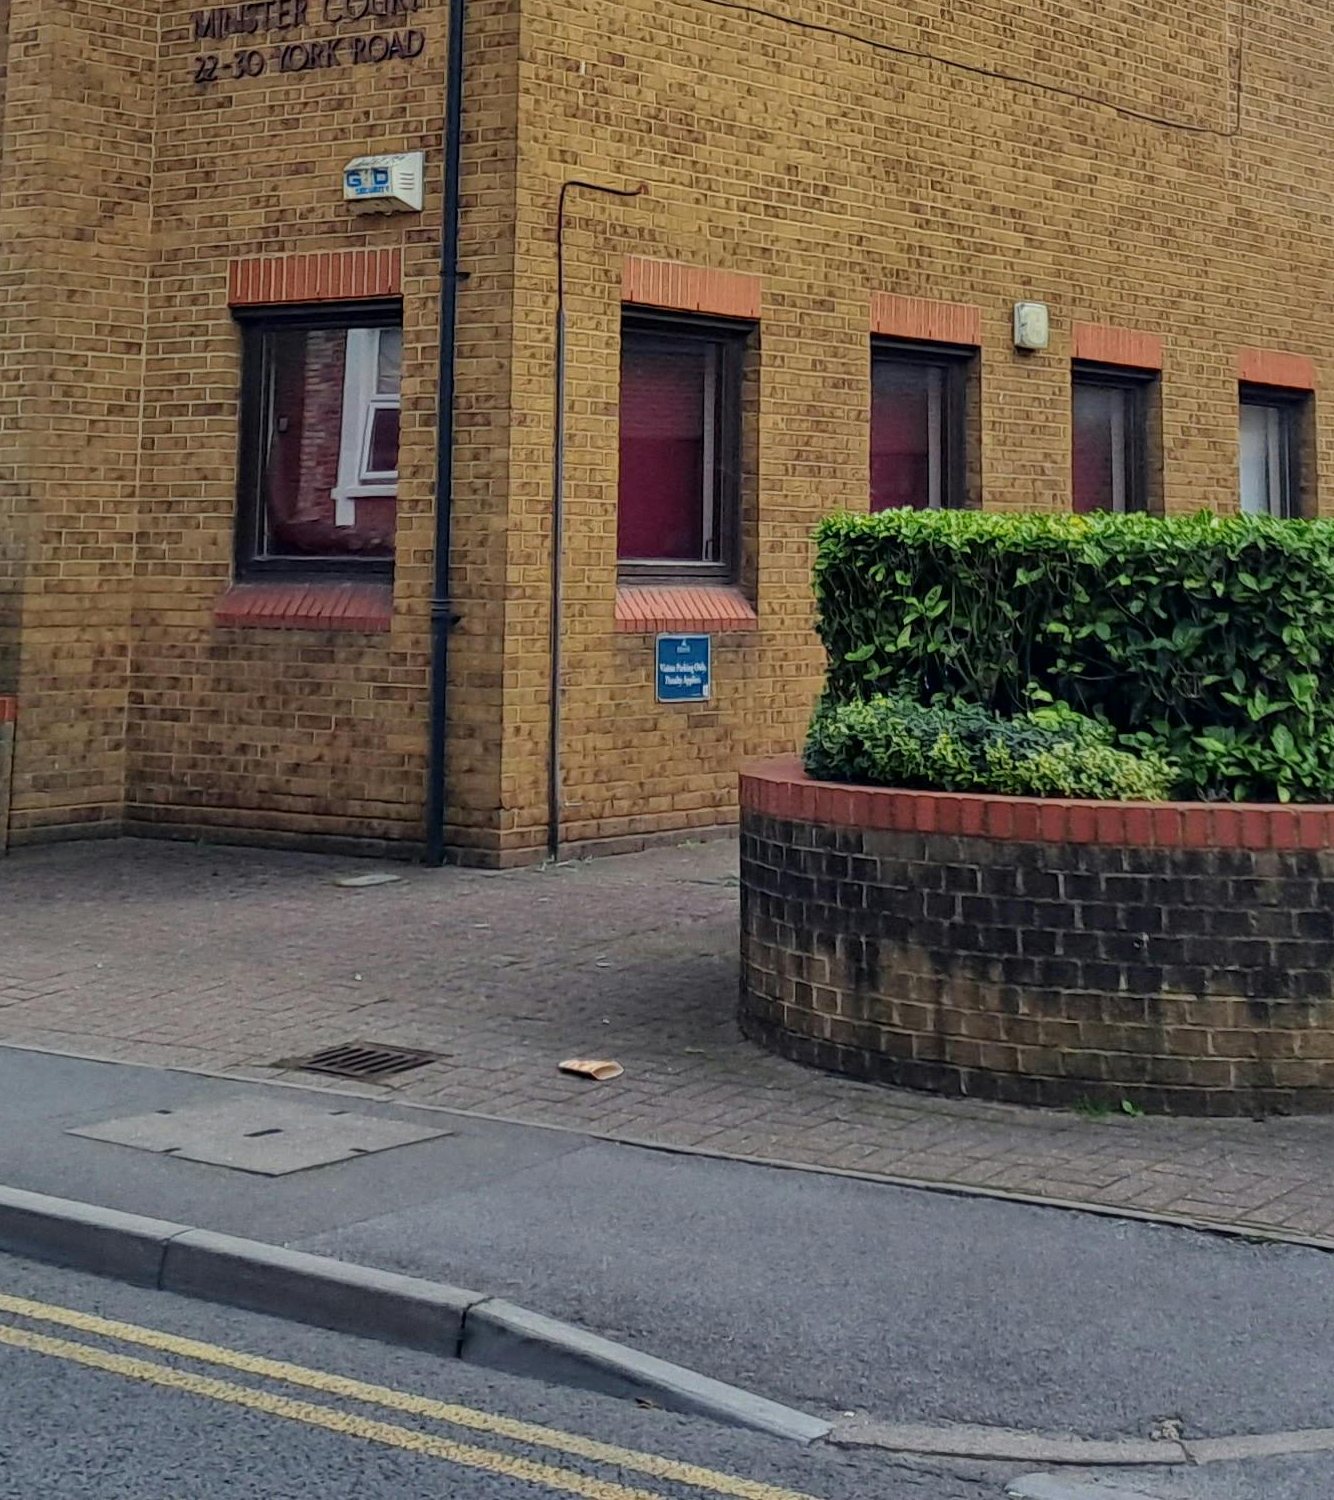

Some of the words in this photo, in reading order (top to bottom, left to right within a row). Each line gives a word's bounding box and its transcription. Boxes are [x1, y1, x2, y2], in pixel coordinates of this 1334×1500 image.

[193, 50, 265, 83] 22-30
[276, 37, 342, 73] YORK
[352, 30, 426, 65] ROAD
